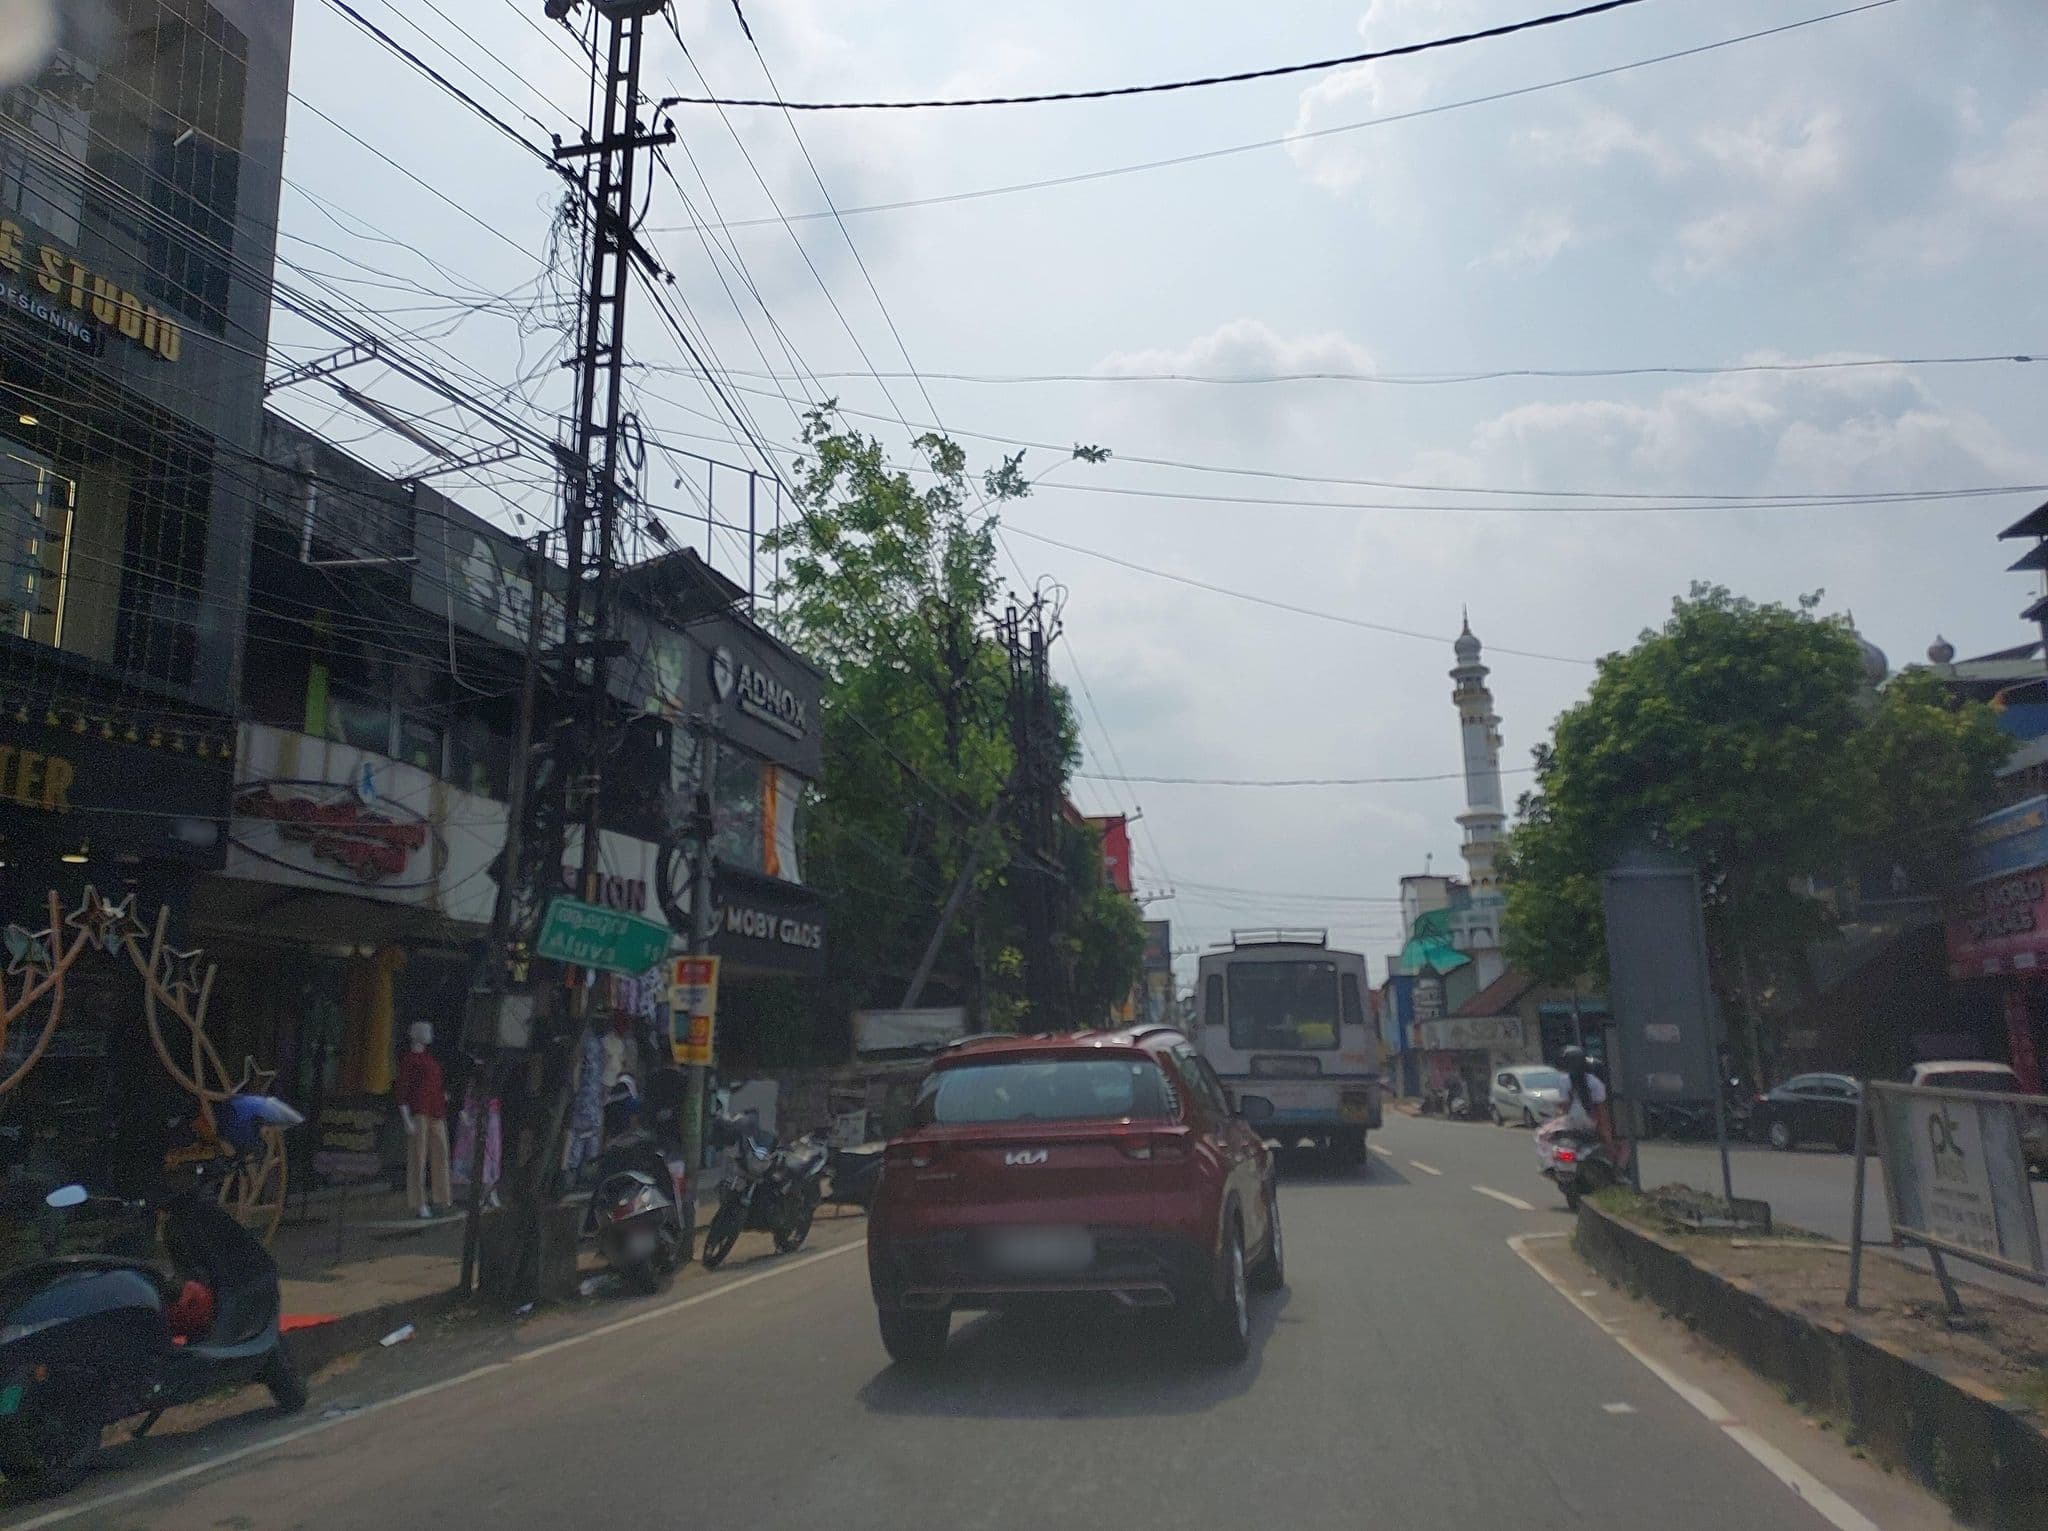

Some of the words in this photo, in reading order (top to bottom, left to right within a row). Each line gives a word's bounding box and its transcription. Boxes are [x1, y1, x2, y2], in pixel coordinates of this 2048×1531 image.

[38, 246, 182, 362] STUDIO
[737, 665, 808, 728] ADNOX
[727, 905, 778, 940] MOBY
